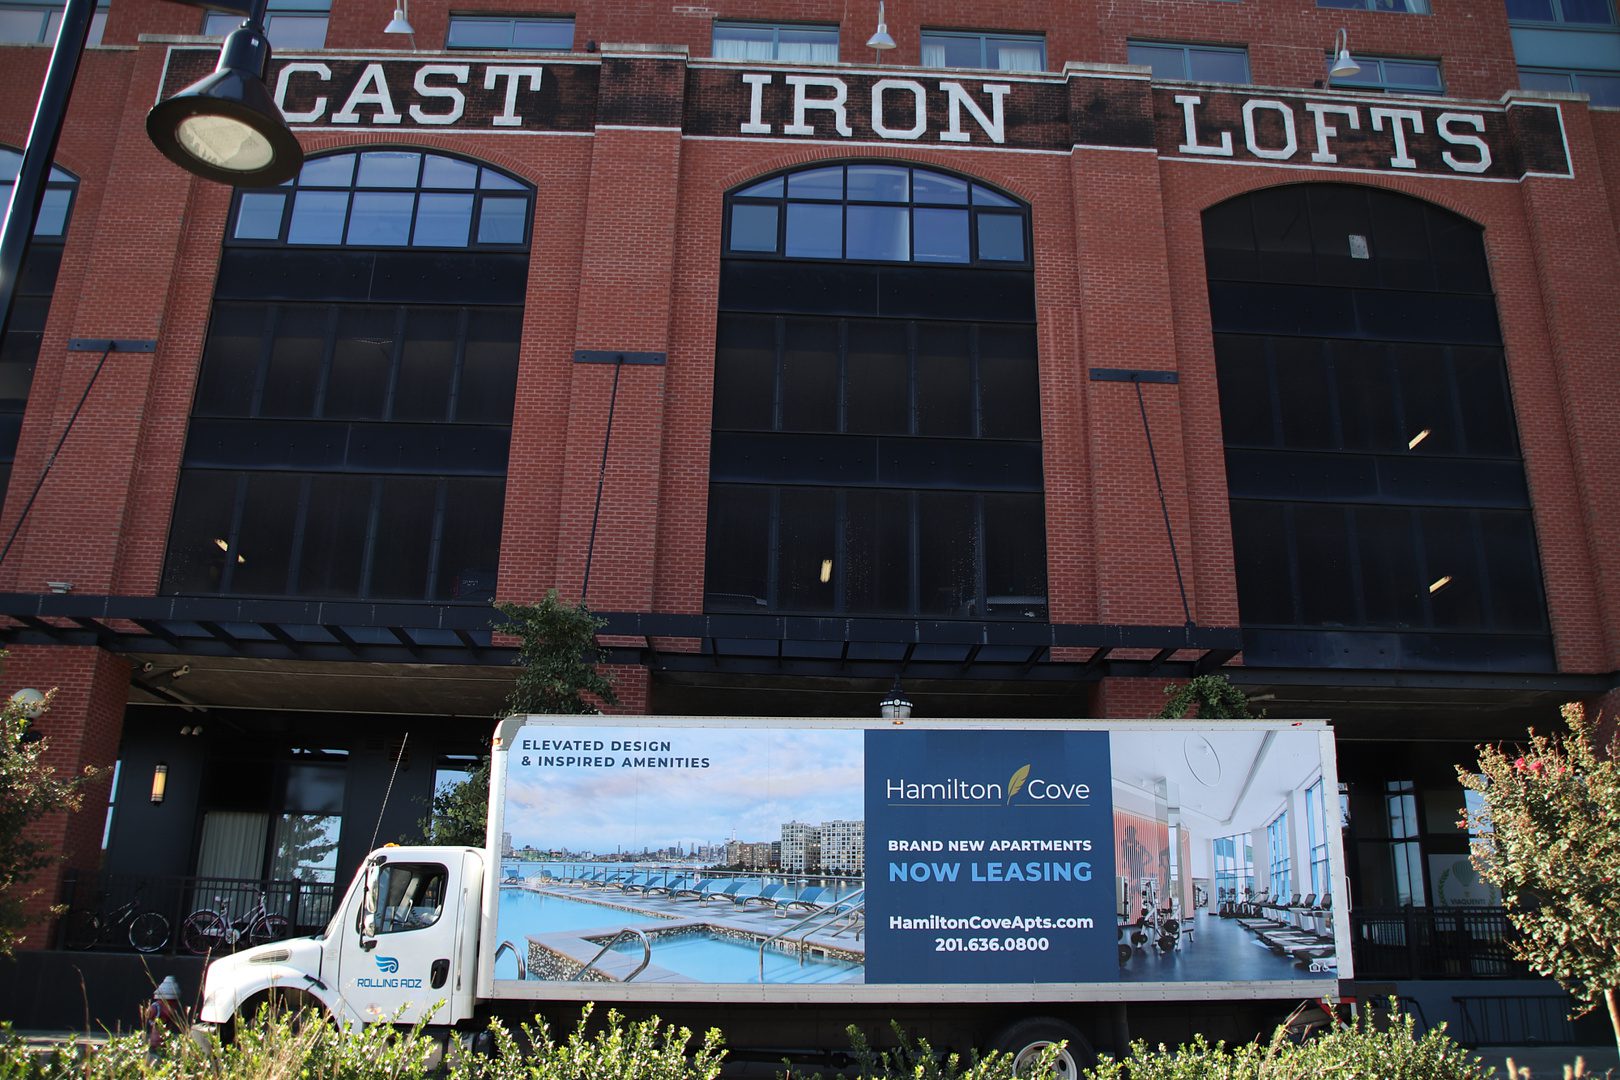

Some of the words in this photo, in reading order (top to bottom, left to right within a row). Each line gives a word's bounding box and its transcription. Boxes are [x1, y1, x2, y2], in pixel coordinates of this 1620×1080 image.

[273, 62, 543, 127] CAST
[740, 73, 1011, 144] IRON
[1174, 94, 1493, 174] LOFTS
[522, 739, 605, 752] ELEVATED
[610, 741, 672, 752] DESIGN
[521, 755, 532, 767] &
[537, 756, 616, 768] INSPIRED
[621, 757, 711, 769] AMENITIES
[886, 778, 1002, 800] Hamilton
[1027, 779, 1091, 800] Cove
[887, 840, 944, 852] BRAND
[948, 840, 985, 852] NEW
[989, 840, 1092, 851] APARTMENTS
[888, 862, 961, 883] NOW
[970, 862, 1093, 883] LEASING
[889, 914, 1094, 932] HamiltonCoveApts.com
[935, 937, 1050, 952] 201.636.0800
[356, 978, 399, 988] ROLLING
[400, 979, 422, 989] ADZ
